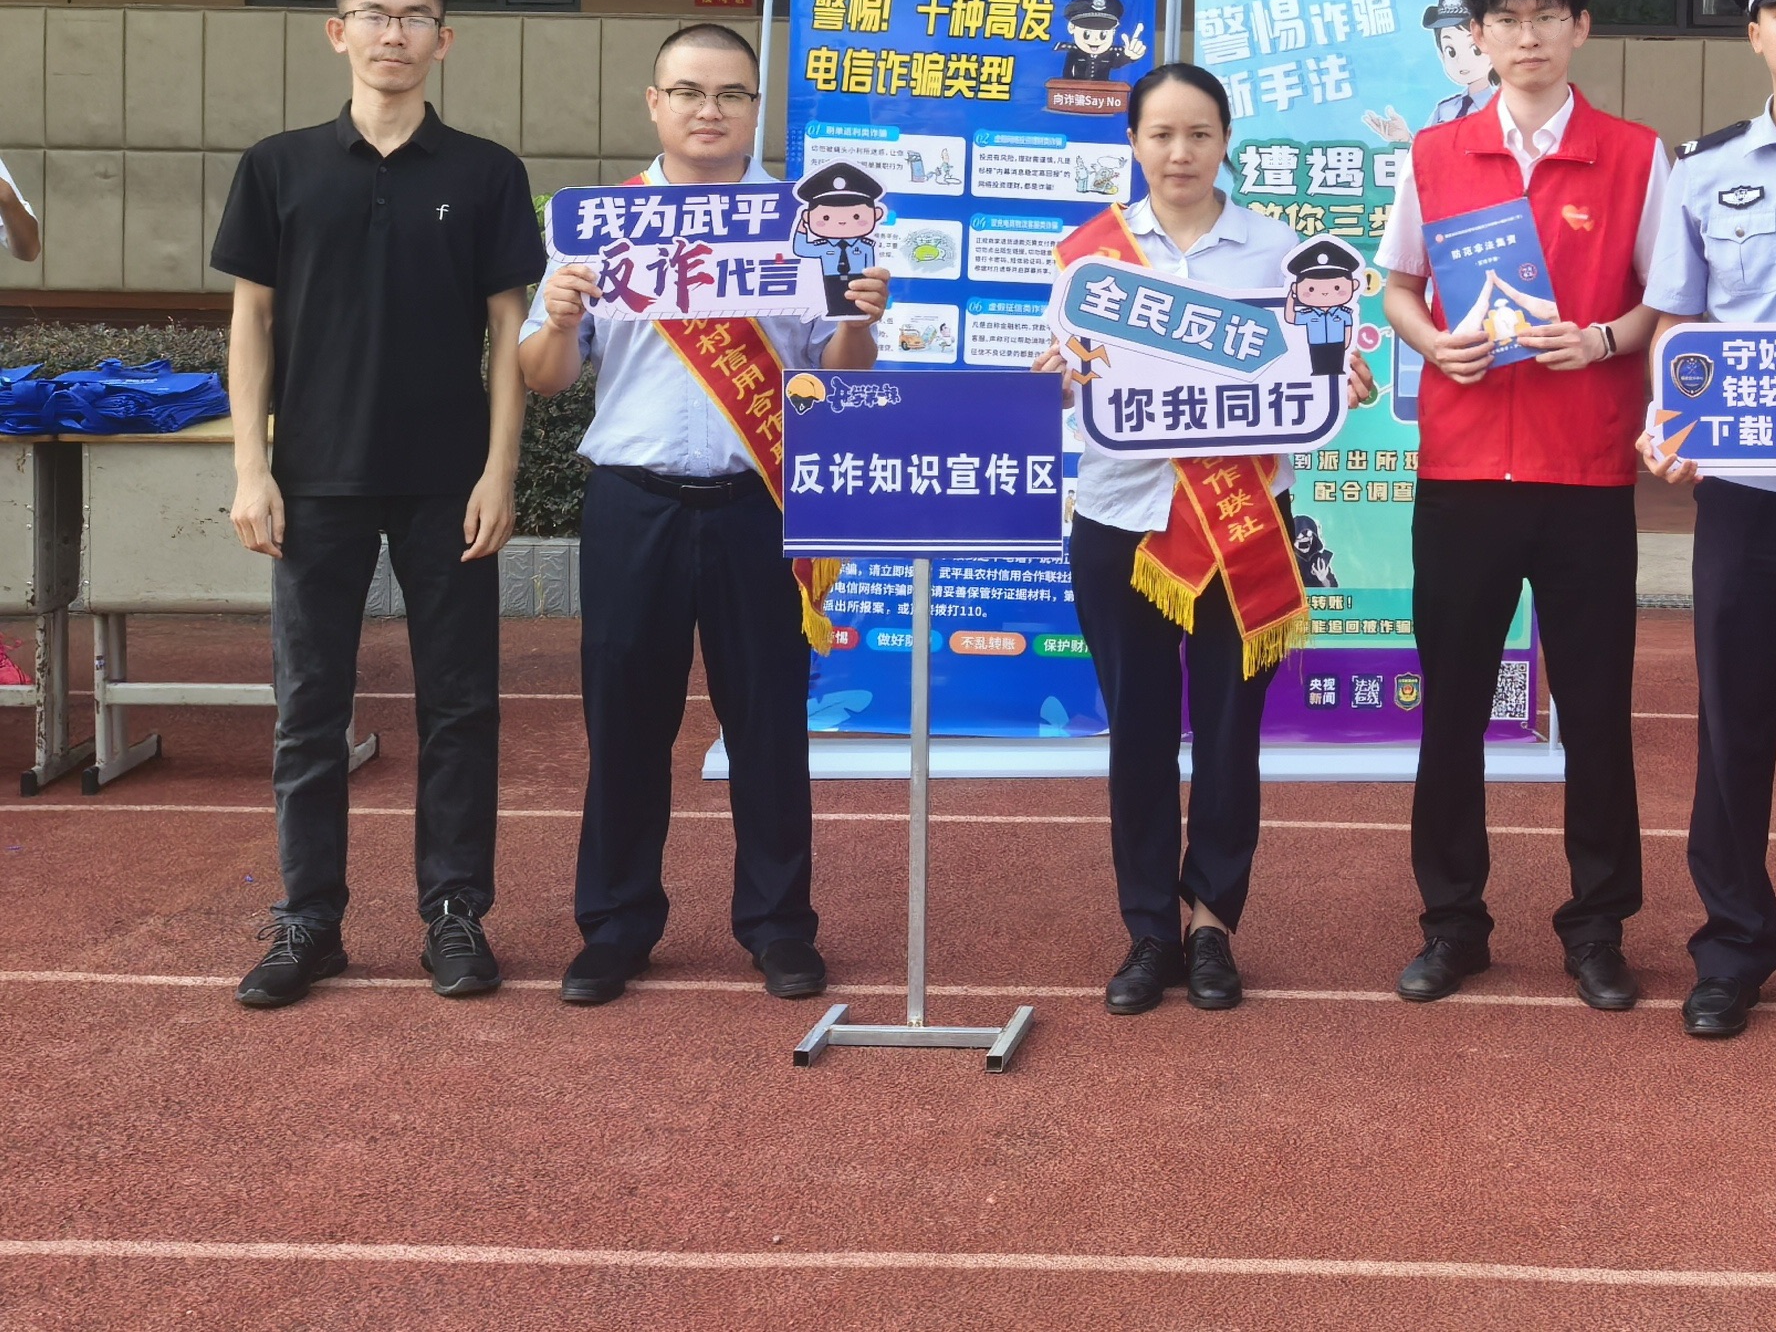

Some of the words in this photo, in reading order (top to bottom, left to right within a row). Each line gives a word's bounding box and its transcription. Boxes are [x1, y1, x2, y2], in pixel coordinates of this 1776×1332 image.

[805, 46, 1014, 102] 电信诈骗类型
[1106, 97, 1121, 107] No
[576, 193, 780, 240] 我为武平
[589, 238, 801, 314] 反诈代言
[1080, 275, 1268, 360] 全民反诈
[1107, 381, 1314, 432] 你我同行
[789, 452, 1057, 495] 反诈知识宣传区
[939, 567, 1072, 583] 武平县农村信用合作联社
[961, 636, 1015, 650] 不乱转账
[1309, 678, 1335, 691] 央视
[1355, 679, 1380, 691] 法治
[1309, 692, 1335, 705] 新闻
[1355, 691, 1380, 705] 在线
